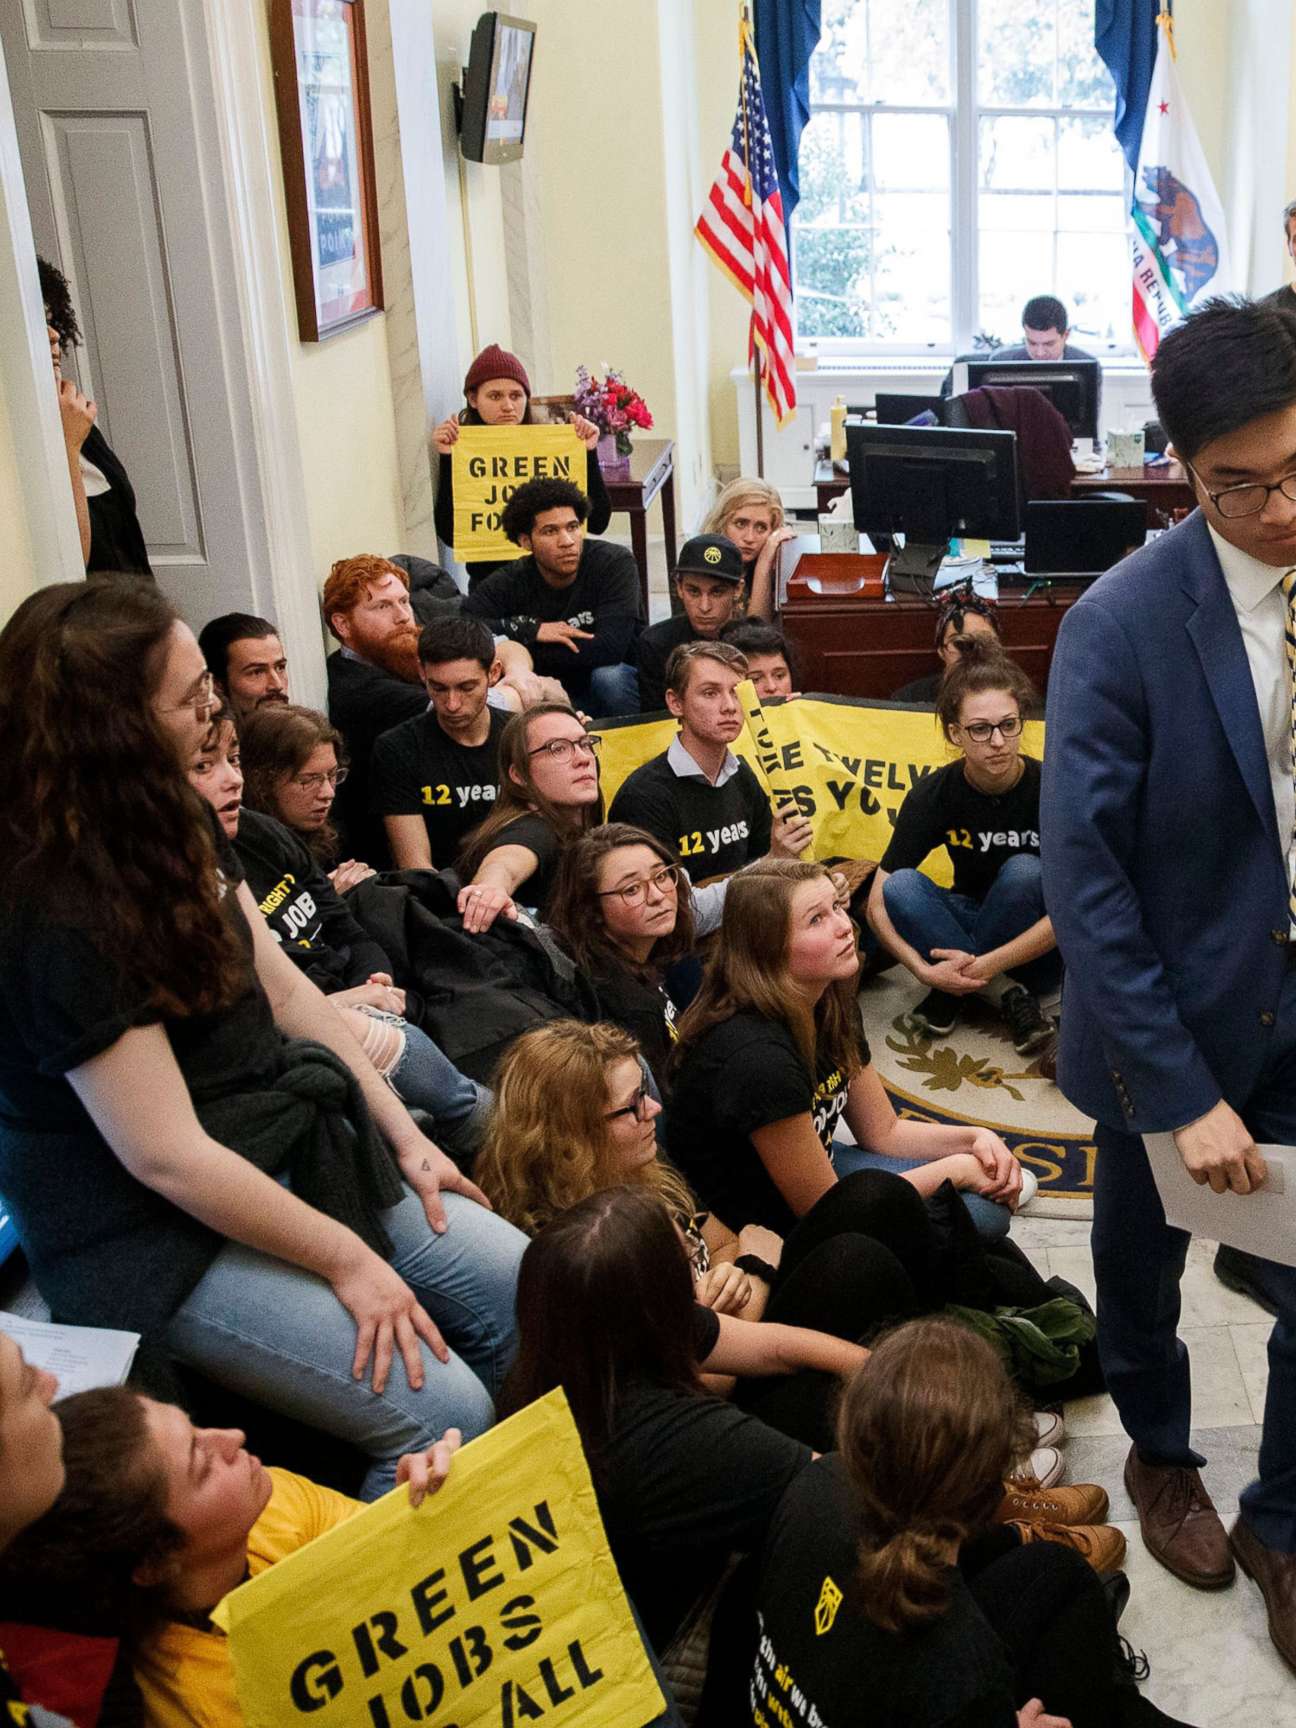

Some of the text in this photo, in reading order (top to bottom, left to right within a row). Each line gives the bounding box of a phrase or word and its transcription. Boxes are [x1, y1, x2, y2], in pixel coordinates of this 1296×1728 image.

[468, 456, 570, 479] GREEN
[484, 484, 516, 505] JO
[471, 512, 502, 532] FO
[421, 783, 502, 808] 12 yea
[679, 831, 705, 856] 12
[946, 828, 1040, 853] 12 years
[289, 1500, 559, 1713] GREEN
[500, 1638, 605, 1728] ALL
[774, 1663, 794, 1692] air
